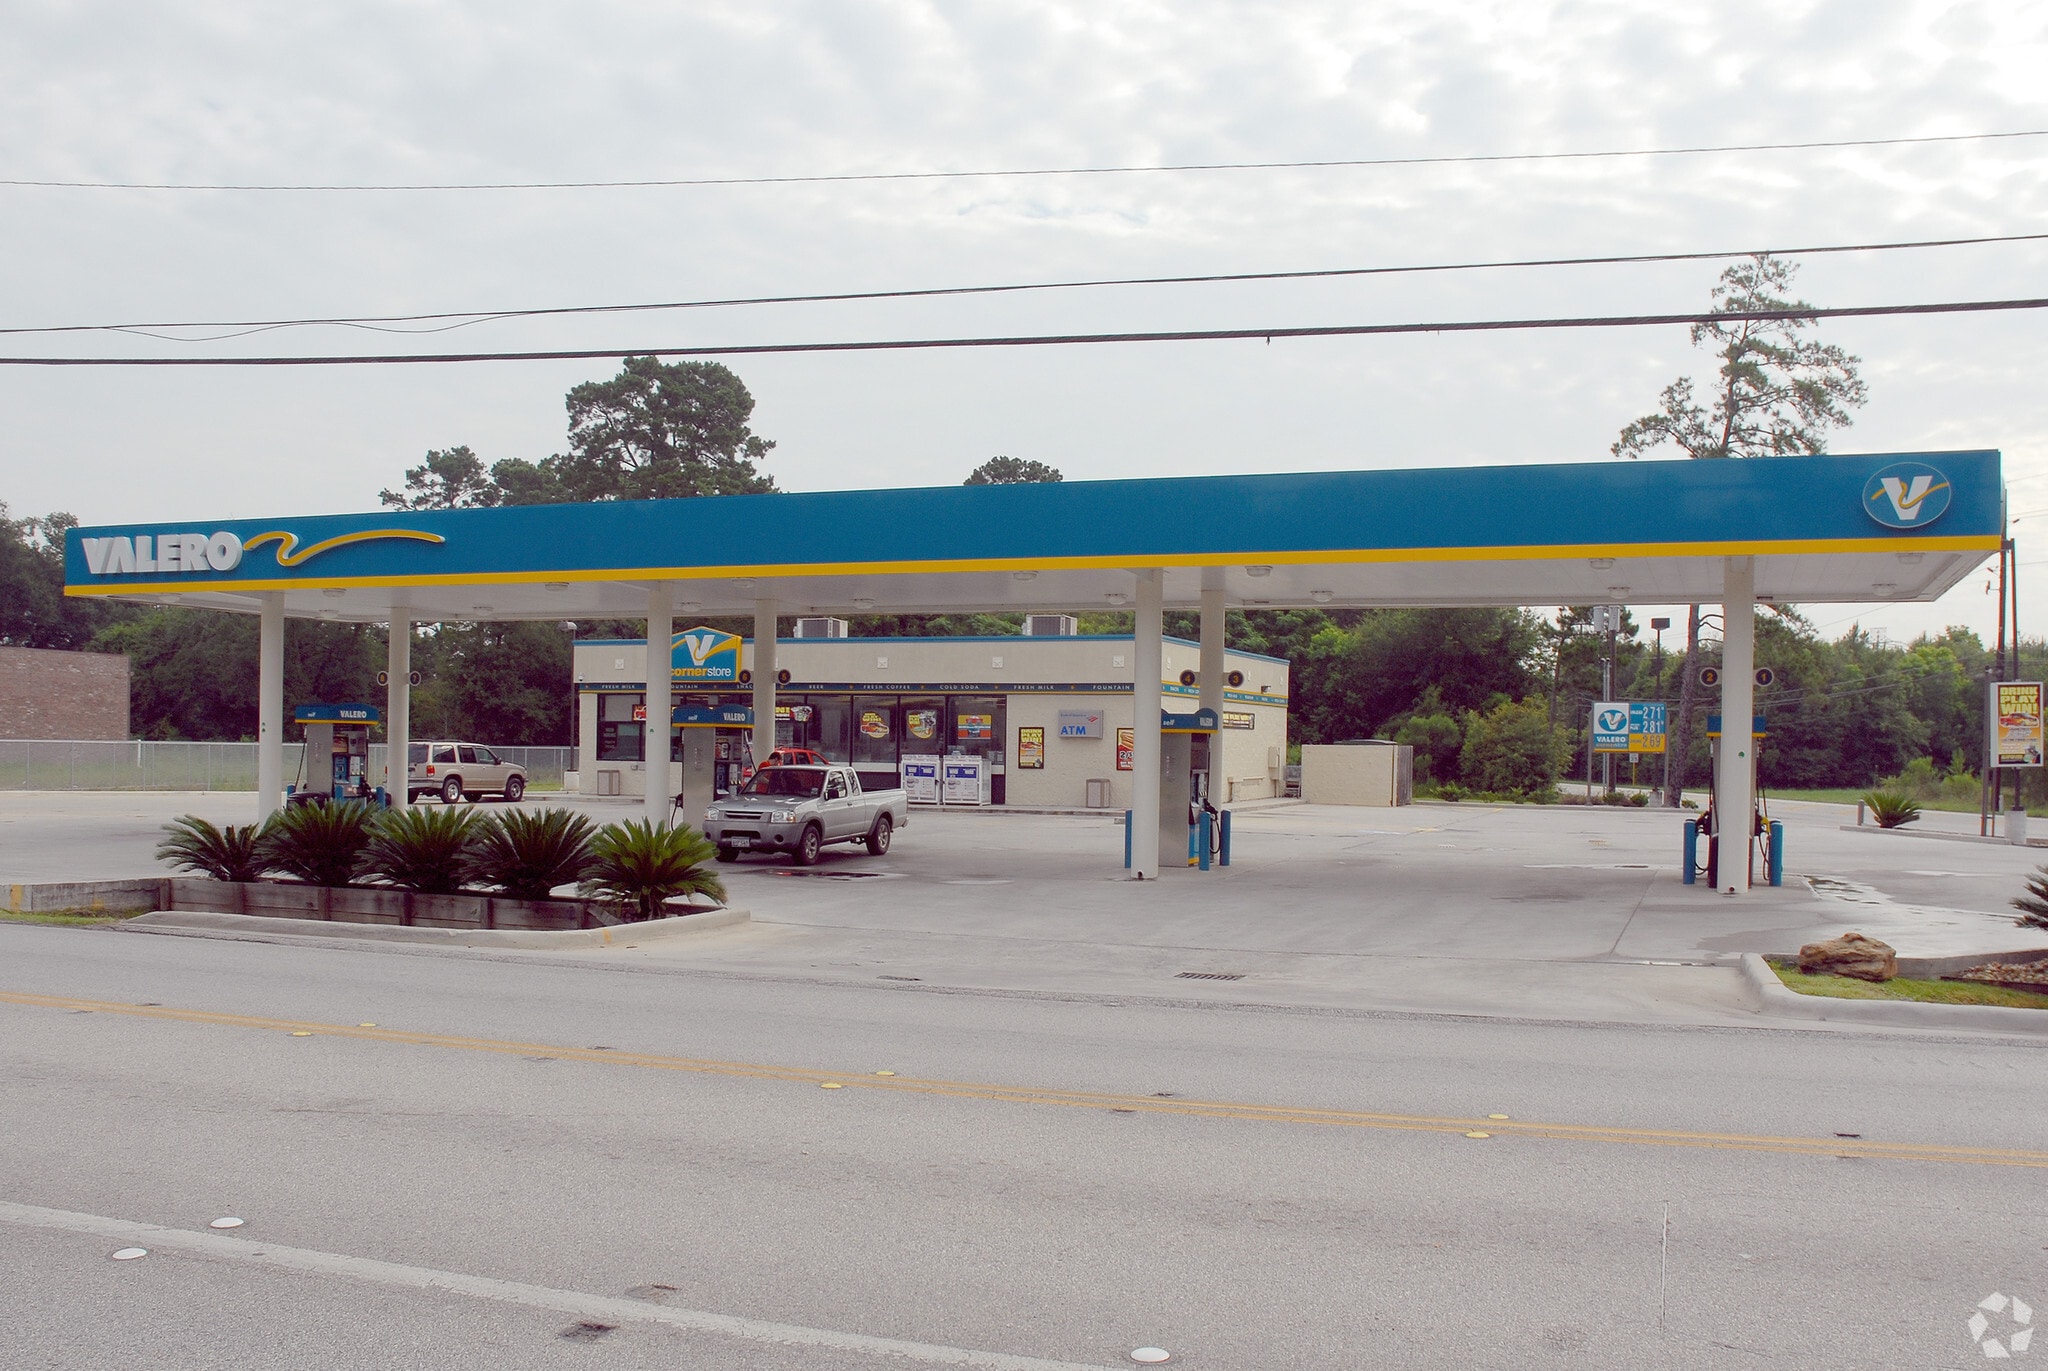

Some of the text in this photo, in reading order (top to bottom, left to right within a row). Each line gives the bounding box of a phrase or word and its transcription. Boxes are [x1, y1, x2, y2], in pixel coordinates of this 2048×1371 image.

[81, 531, 243, 575] VALERO
[2000, 686, 2038, 695] DRINK
[2000, 695, 2038, 703] PLAY
[2000, 703, 2038, 714] WIN!
[340, 710, 367, 719] VALERO
[723, 712, 746, 721] VALERO
[1060, 725, 1086, 735] ATM
